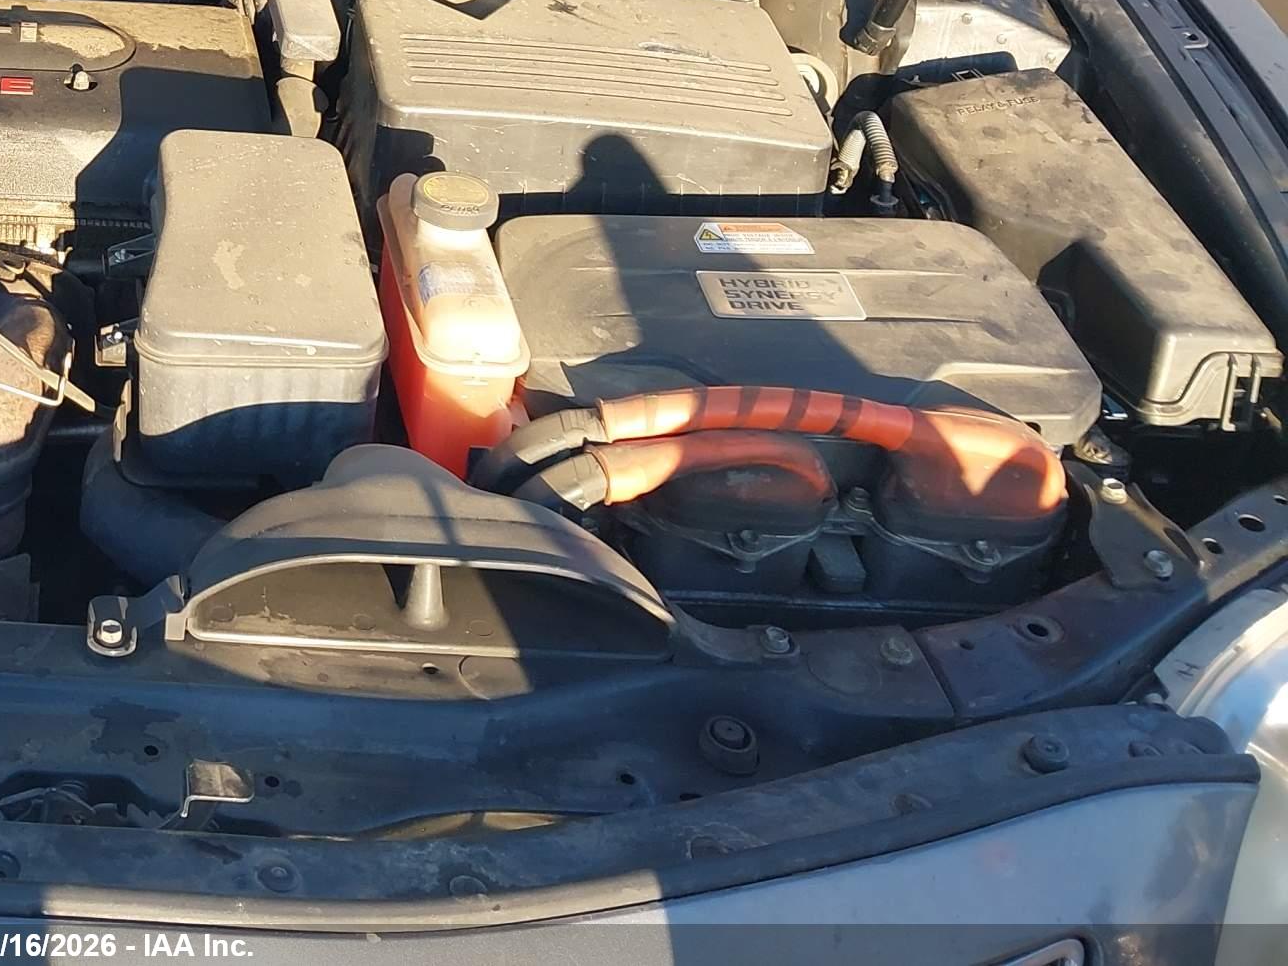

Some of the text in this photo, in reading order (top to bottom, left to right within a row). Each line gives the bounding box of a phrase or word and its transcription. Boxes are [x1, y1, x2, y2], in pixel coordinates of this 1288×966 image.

[957, 102, 995, 116] RELAY
[1007, 96, 1039, 107] FUSE
[719, 277, 810, 290] HYBRID
[724, 289, 840, 301] SYNERGY
[728, 300, 804, 312] DRIVE
